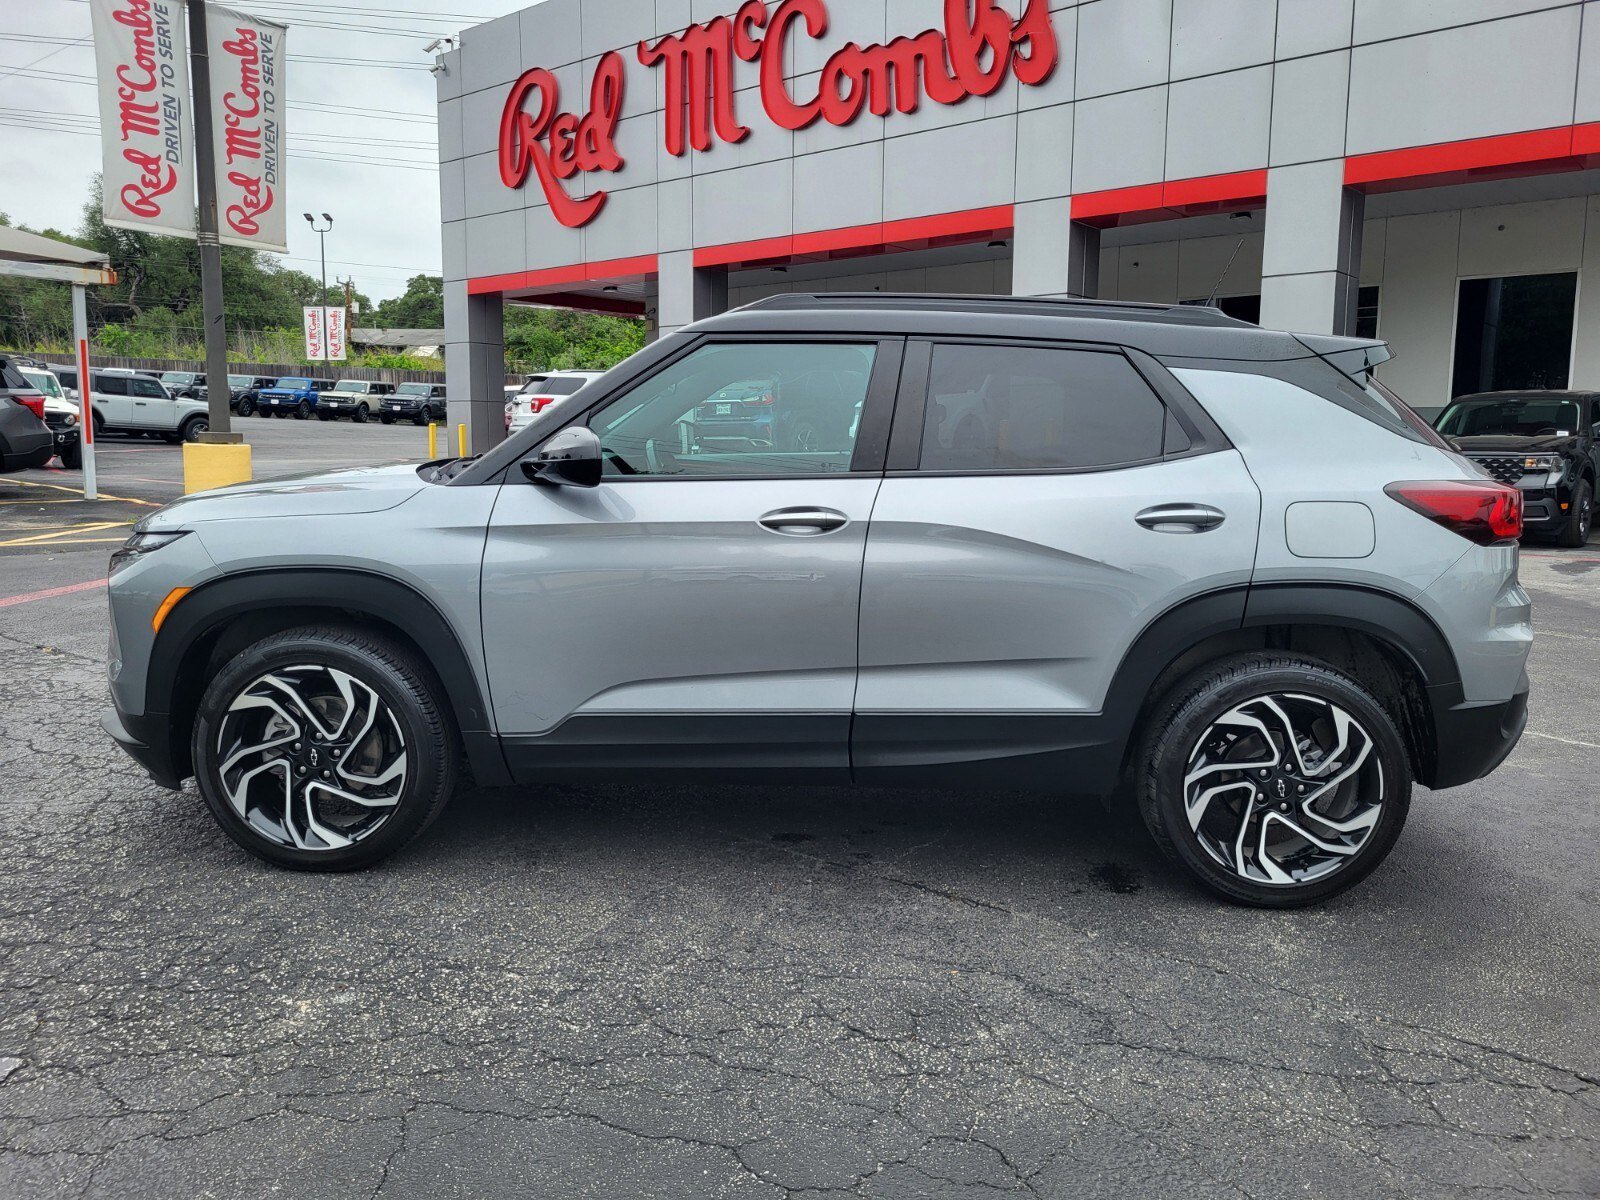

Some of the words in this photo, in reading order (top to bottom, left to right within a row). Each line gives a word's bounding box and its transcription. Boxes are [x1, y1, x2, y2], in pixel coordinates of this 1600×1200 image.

[153, 2, 173, 61] SERVE
[259, 31, 274, 88] SERVE
[112, 0, 160, 141] McCombs
[159, 63, 175, 90] TO
[222, 27, 262, 165] McCombs
[263, 90, 276, 116] TO
[165, 94, 180, 165] DRIVEN
[498, 51, 626, 229] Red
[636, 0, 1060, 157] McCombs
[120, 148, 177, 218] Red
[264, 120, 276, 186] DRIVEN
[226, 171, 273, 236] Red
[310, 342, 321, 357] Red
[330, 342, 341, 357] Red
